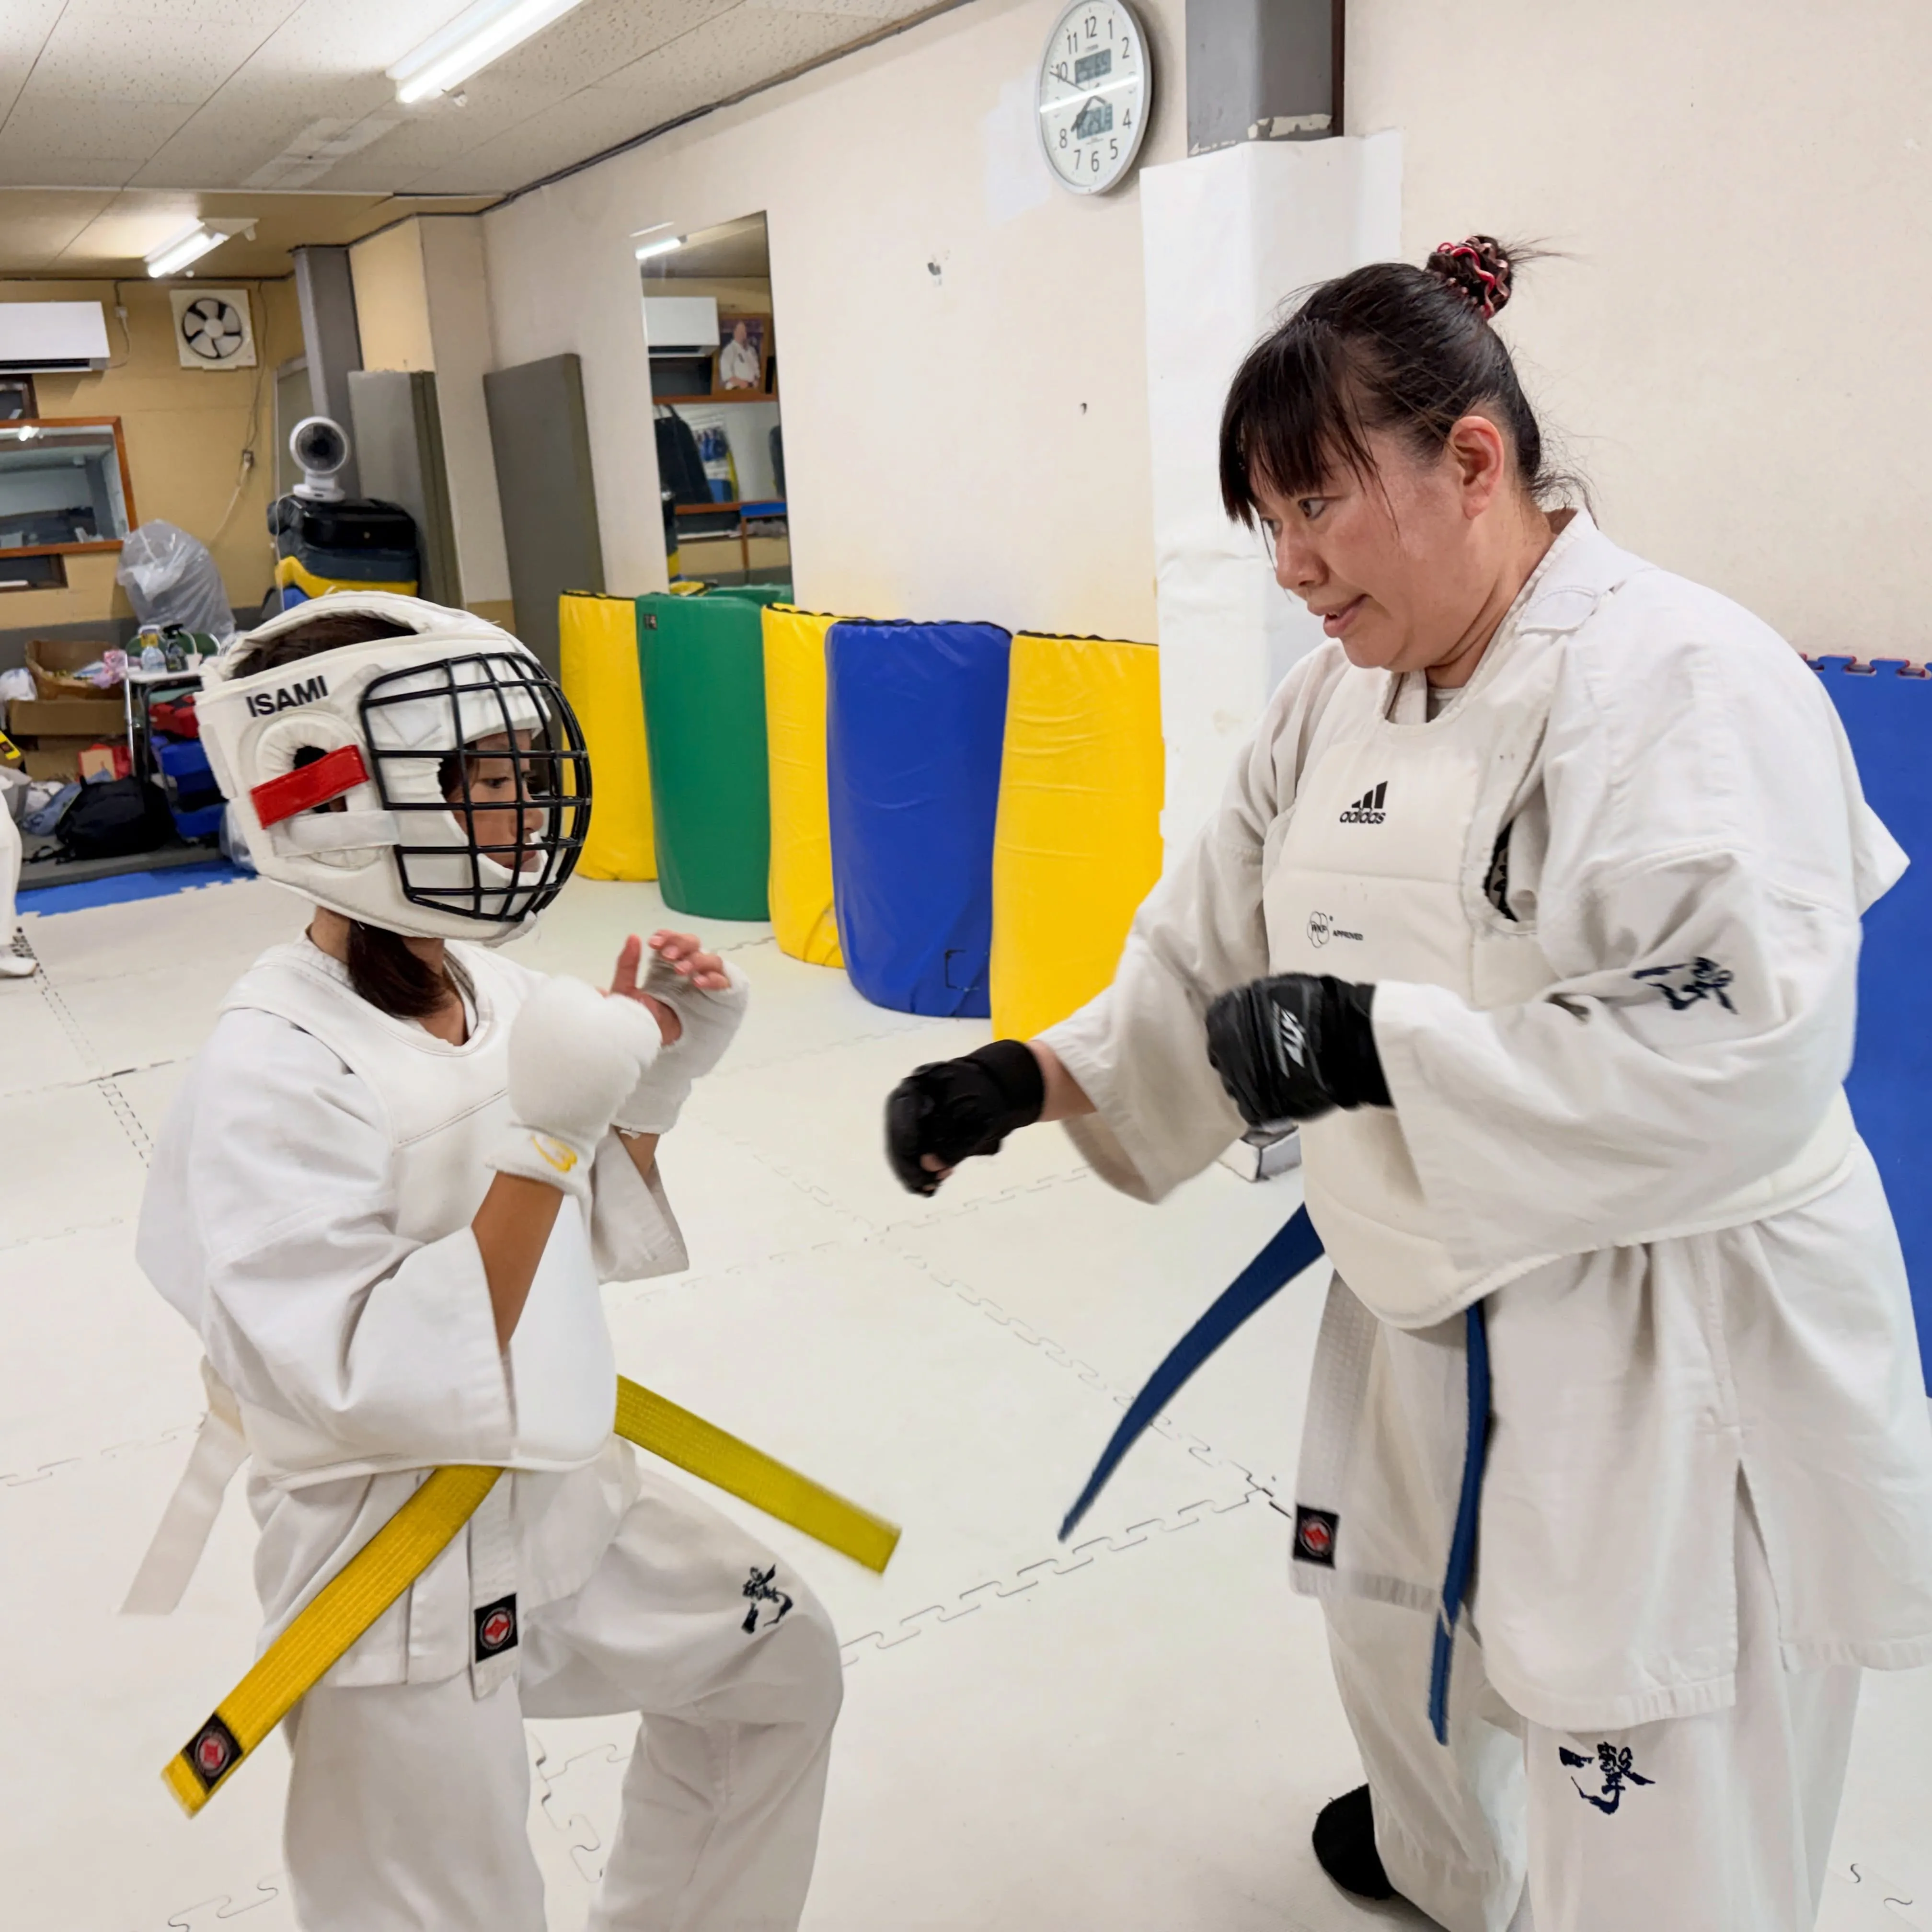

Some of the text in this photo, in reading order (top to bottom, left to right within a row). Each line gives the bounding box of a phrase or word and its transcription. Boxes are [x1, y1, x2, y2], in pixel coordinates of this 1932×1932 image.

[1085, 16, 1097, 39] 12
[1108, 19, 1113, 40] 1
[1067, 32, 1078, 55] 11
[1122, 37, 1130, 59] 2
[1122, 108, 1132, 129] 4
[1059, 128, 1068, 149] 8
[1110, 138, 1118, 160] 5
[1074, 149, 1081, 170] 7
[1091, 151, 1099, 172] 6
[246, 675, 329, 717] ISAMI
[1340, 808, 1386, 825] adidas
